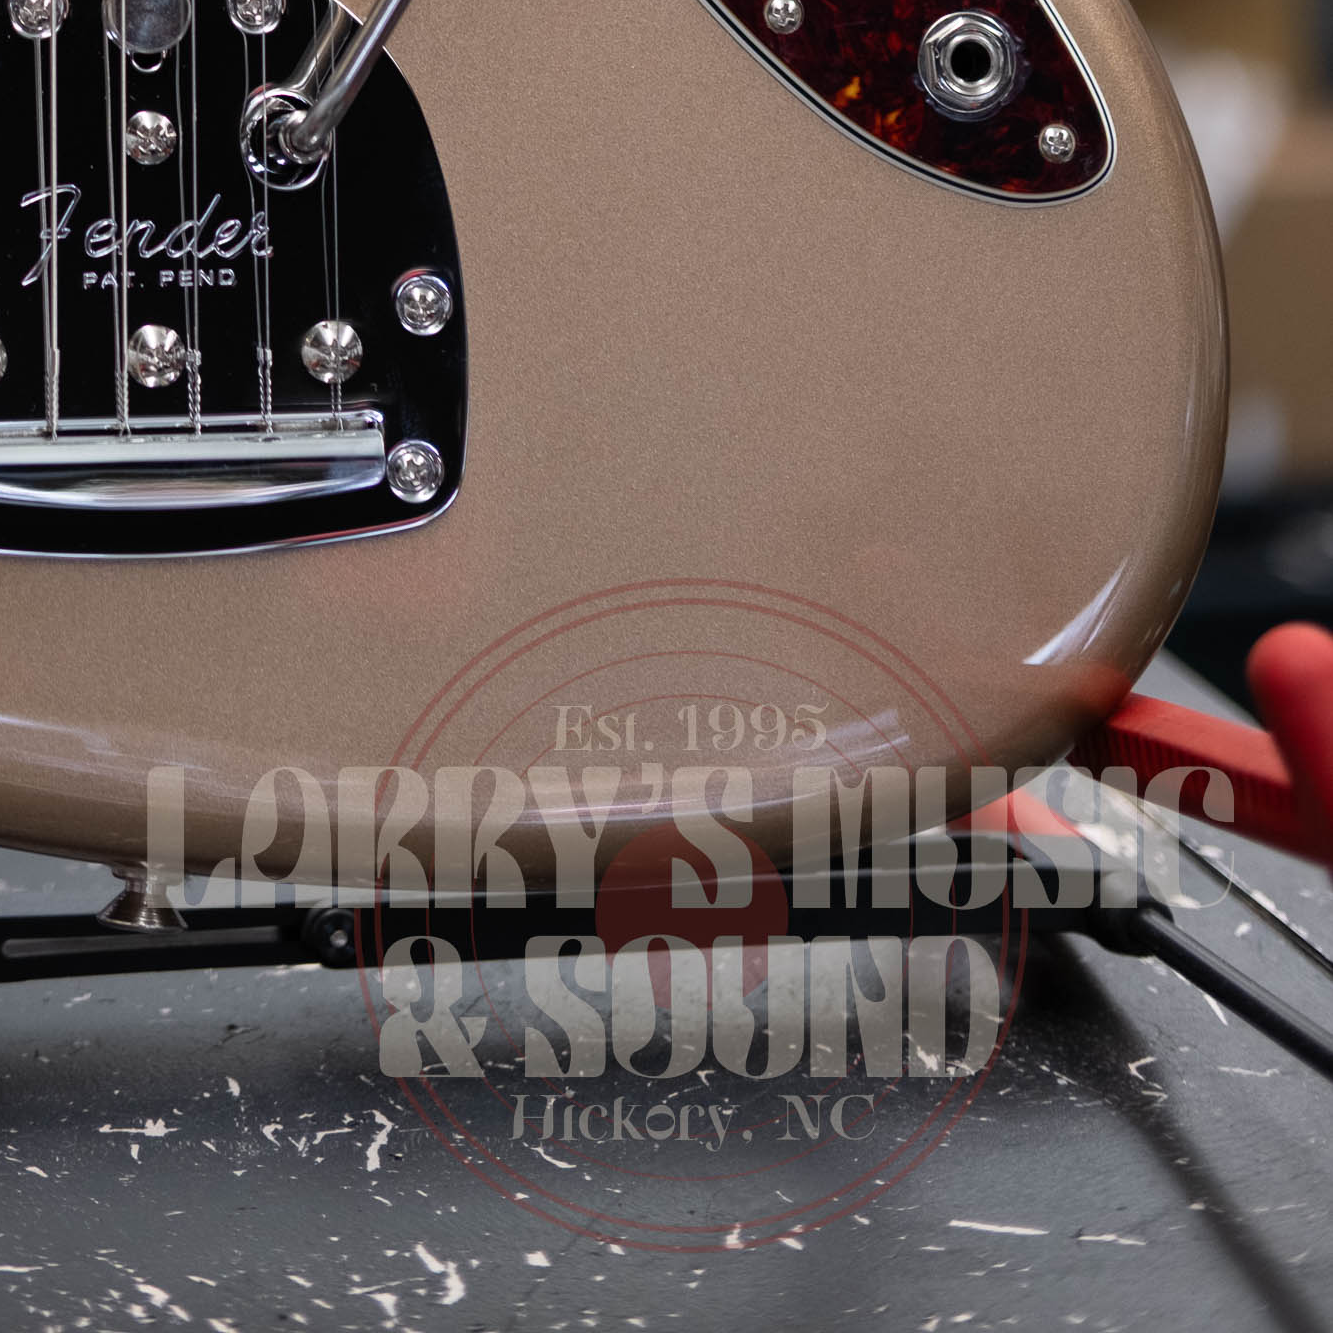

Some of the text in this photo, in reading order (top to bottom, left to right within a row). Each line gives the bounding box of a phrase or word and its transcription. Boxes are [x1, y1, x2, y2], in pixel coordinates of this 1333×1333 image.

[20, 184, 274, 286] Fender
[82, 268, 238, 290] PAT. PEND
